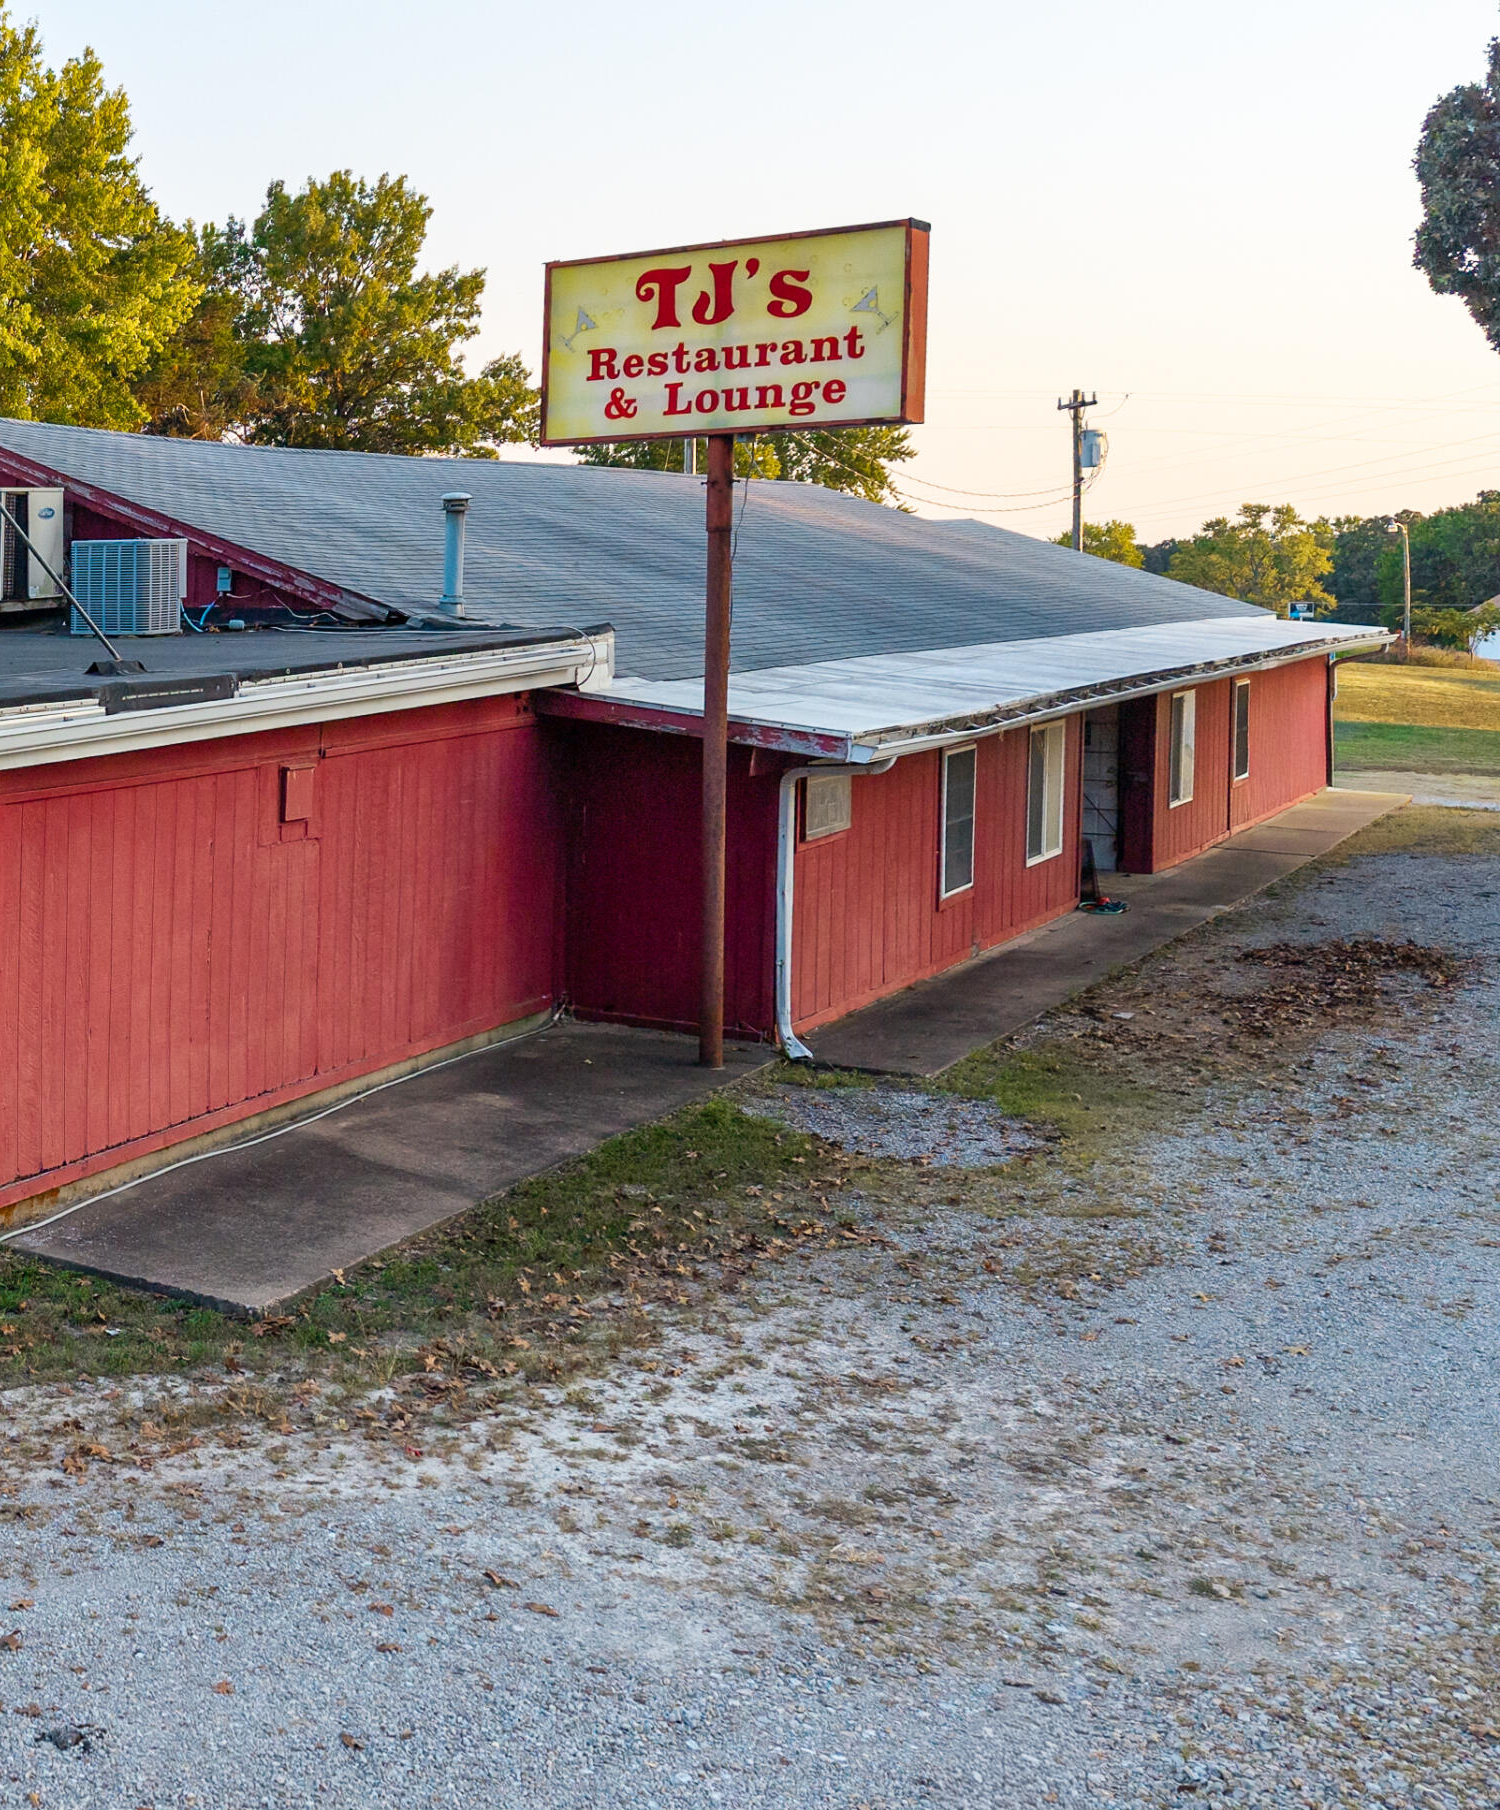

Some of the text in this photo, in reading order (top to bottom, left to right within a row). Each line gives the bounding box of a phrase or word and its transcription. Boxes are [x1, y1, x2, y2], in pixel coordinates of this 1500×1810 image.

[635, 257, 813, 330] TJ's
[586, 325, 865, 381] Restaurant
[604, 378, 847, 420] & Lounge
